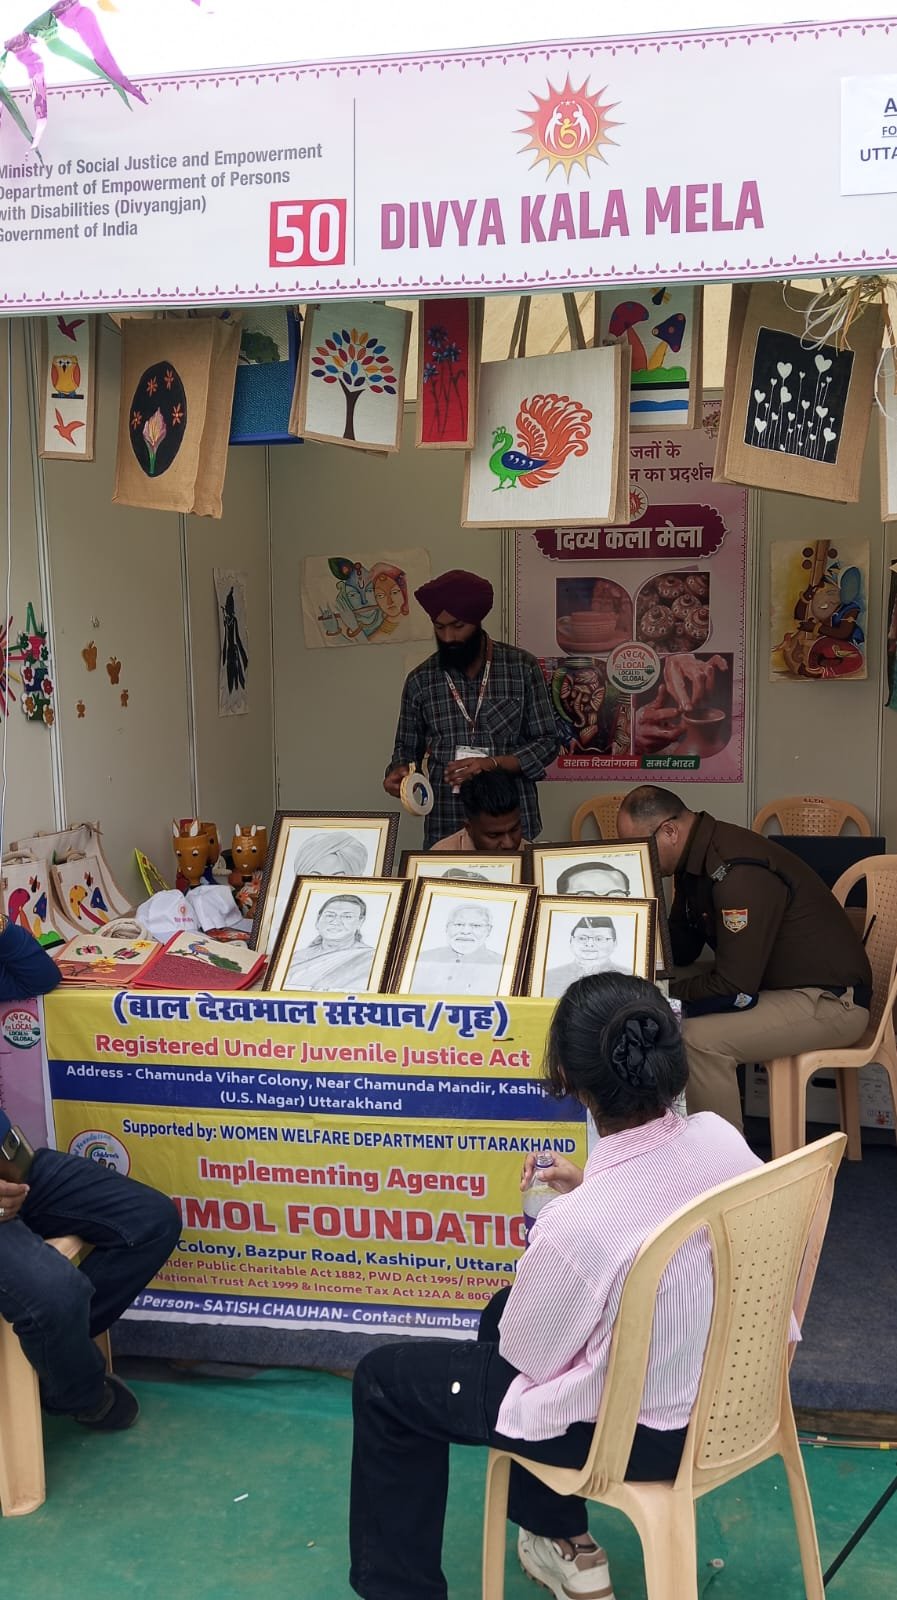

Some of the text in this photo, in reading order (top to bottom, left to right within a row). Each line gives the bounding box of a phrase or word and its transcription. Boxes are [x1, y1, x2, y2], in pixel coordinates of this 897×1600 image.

[0, 144, 322, 179] Ministry of Social Justice and Empowerment
[83, 180, 97, 195] of
[101, 173, 206, 199] Empowerment
[211, 172, 226, 188] of
[230, 169, 290, 187] Persons
[31, 201, 110, 219] Disabilities
[115, 197, 206, 219] (Divyangjan)
[380, 180, 764, 250] DIVYA KALA MELA
[84, 222, 98, 237] of
[102, 221, 138, 238] India
[275, 203, 340, 263] 50
[629, 440, 682, 459] जनों के
[643, 468, 666, 482] का
[555, 519, 704, 550] दिव्य कला मेला
[623, 661, 645, 669] LOCAL
[563, 758, 589, 767] सशक्त
[646, 758, 671, 768] समर्थ
[672, 759, 695, 768] भारत
[113, 991, 190, 1024] (बाल
[196, 992, 317, 1025] देखभाल
[96, 1035, 530, 1067] Registered Under Juvenile Justice Act
[66, 1065, 123, 1079] Address
[135, 1068, 212, 1083] Chamunda
[216, 1072, 254, 1085] Vihar
[258, 1074, 312, 1090] Colony,
[316, 1077, 350, 1089] Near
[354, 1078, 434, 1092] Chamunda
[439, 1081, 496, 1096] Mandir,
[220, 1092, 402, 1111] (U.S. Nagar) Uttarakhand
[123, 1119, 576, 1153] Supported by: WOMEN WELFARE DEPARTMENT UTTARAKHAND
[200, 1158, 485, 1197] Implementing Agency
[177, 1240, 241, 1258] Colony,
[246, 1245, 306, 1262] Bazpur
[312, 1249, 361, 1265] Road,
[366, 1252, 451, 1271] Kashipur,
[155, 1272, 208, 1284] National
[211, 1275, 244, 1287] Trust
[248, 1278, 270, 1289] Act
[272, 1280, 298, 1290] 1999
[302, 1281, 311, 1291] &
[314, 1284, 362, 1295] Income
[366, 1286, 388, 1297] Tax
[392, 1287, 415, 1298] Act
[418, 1289, 451, 1299] 12AA
[455, 1290, 465, 1300] &
[166, 1258, 511, 1288] nder Public Charitable Act 1882, PWD Act 1995/ RPWD
[141, 1295, 200, 1310] Person-
[203, 1299, 259, 1314] SATISH
[262, 1302, 348, 1321] CHAUHAN-
[352, 1308, 415, 1325] Contact
